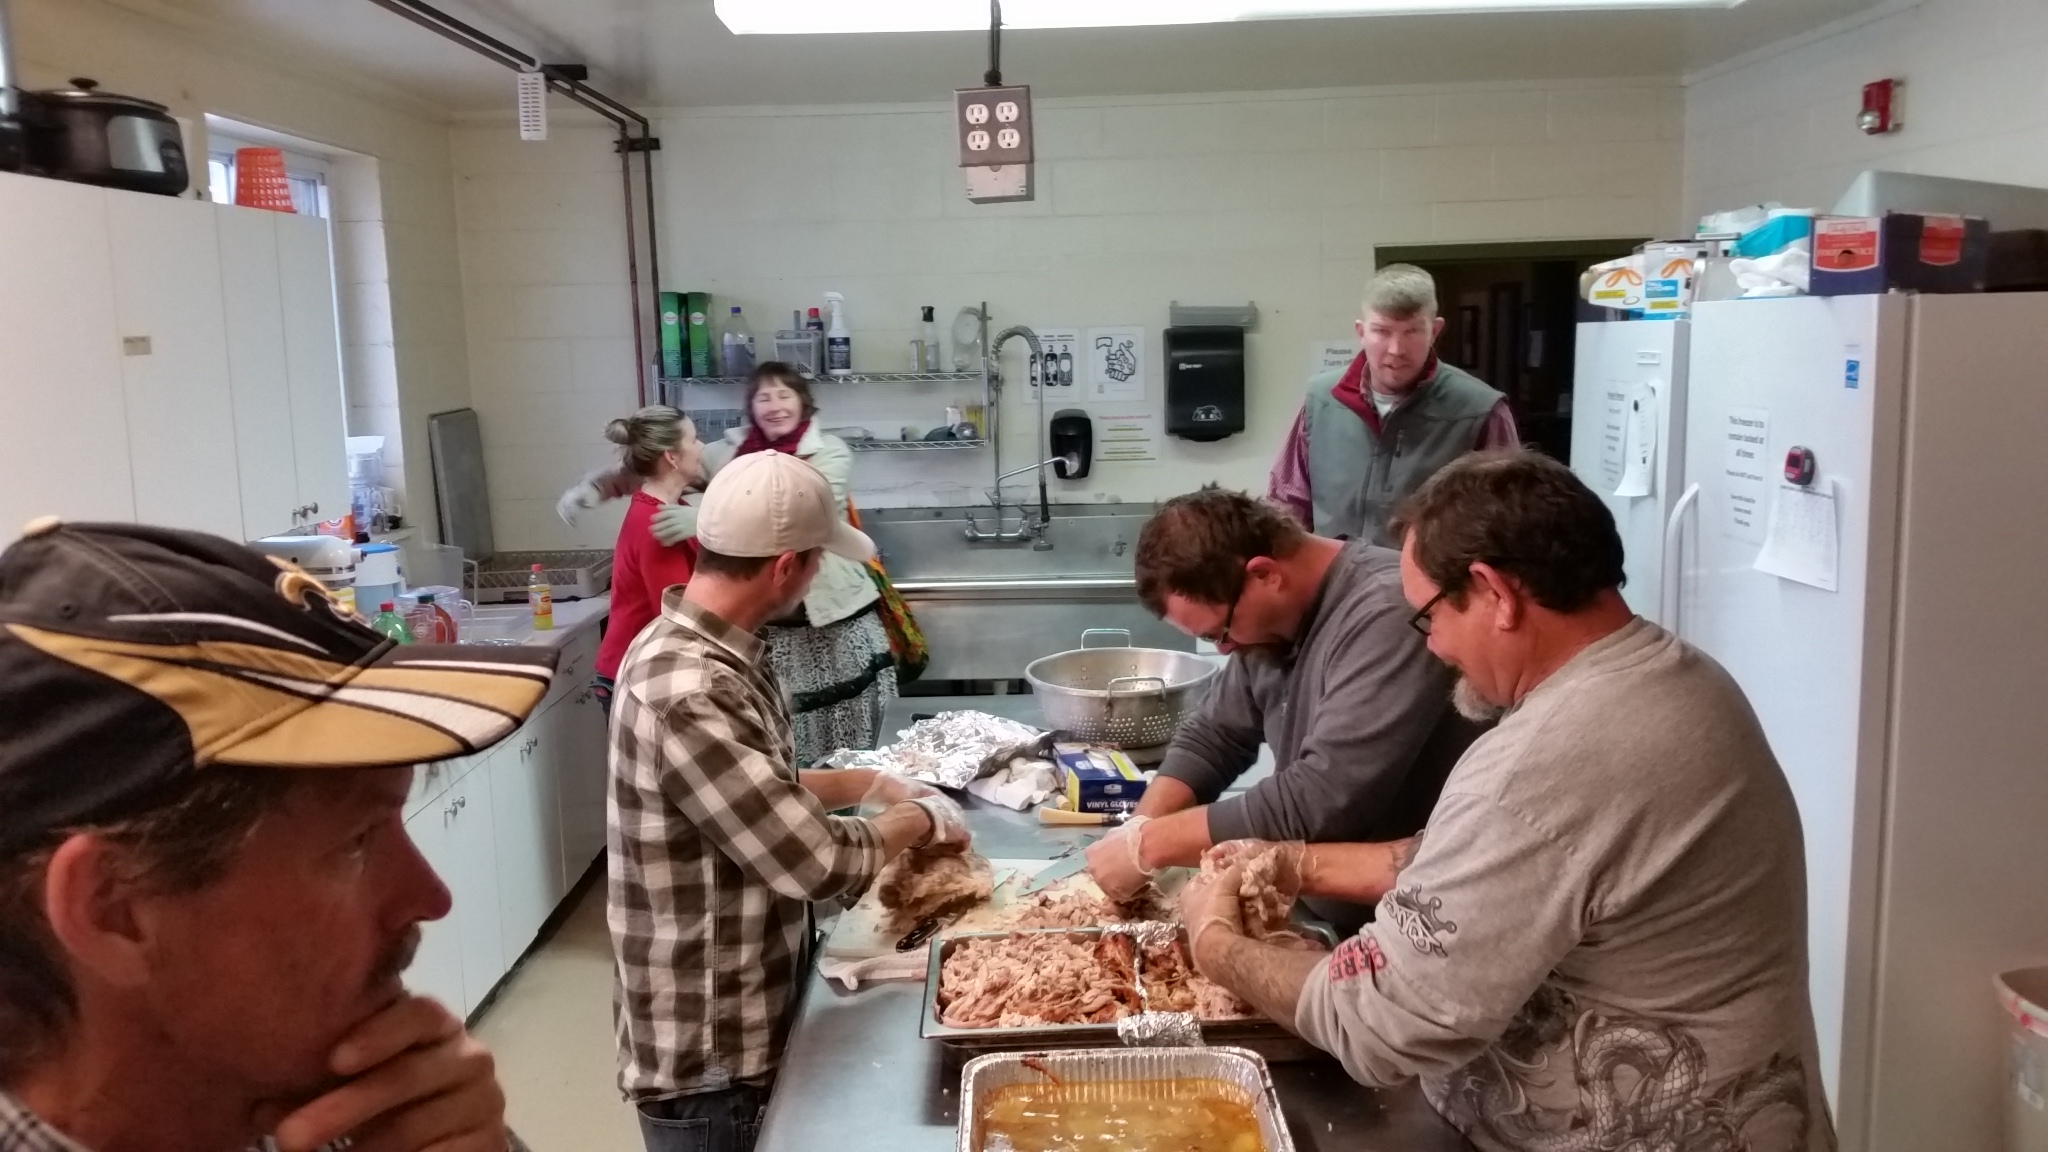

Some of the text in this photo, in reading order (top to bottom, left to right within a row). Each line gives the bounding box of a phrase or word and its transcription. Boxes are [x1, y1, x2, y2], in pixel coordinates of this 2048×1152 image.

[1048, 345, 1054, 353] 2
[1323, 359, 1342, 367] Turn
[1086, 801, 1109, 809] VINYL
